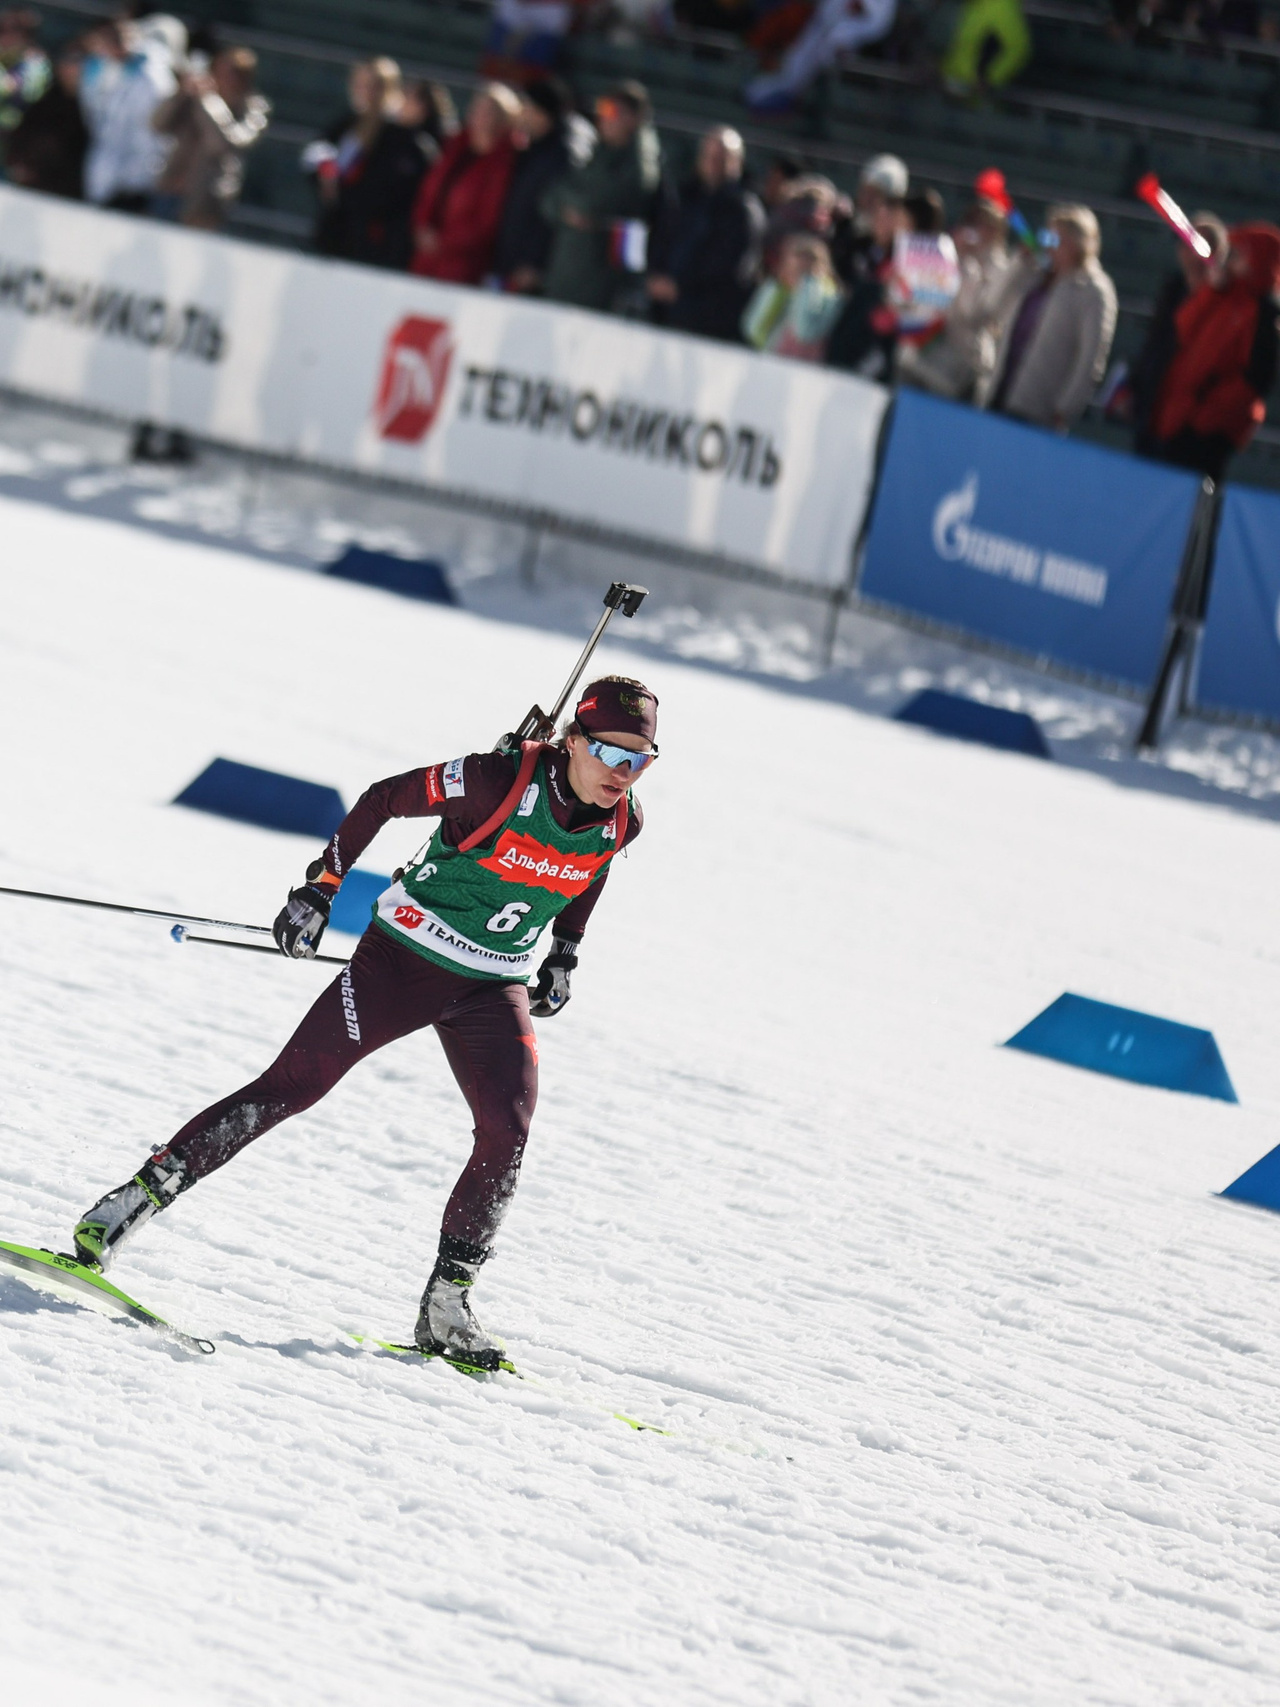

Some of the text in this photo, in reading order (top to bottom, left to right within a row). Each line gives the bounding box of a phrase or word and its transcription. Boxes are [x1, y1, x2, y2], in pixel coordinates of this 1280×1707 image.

[459, 365, 782, 490] ТЕХНОНИКОЛЬ
[415, 863, 438, 881] 6
[498, 847, 560, 877] Альфа
[485, 901, 533, 933] 6
